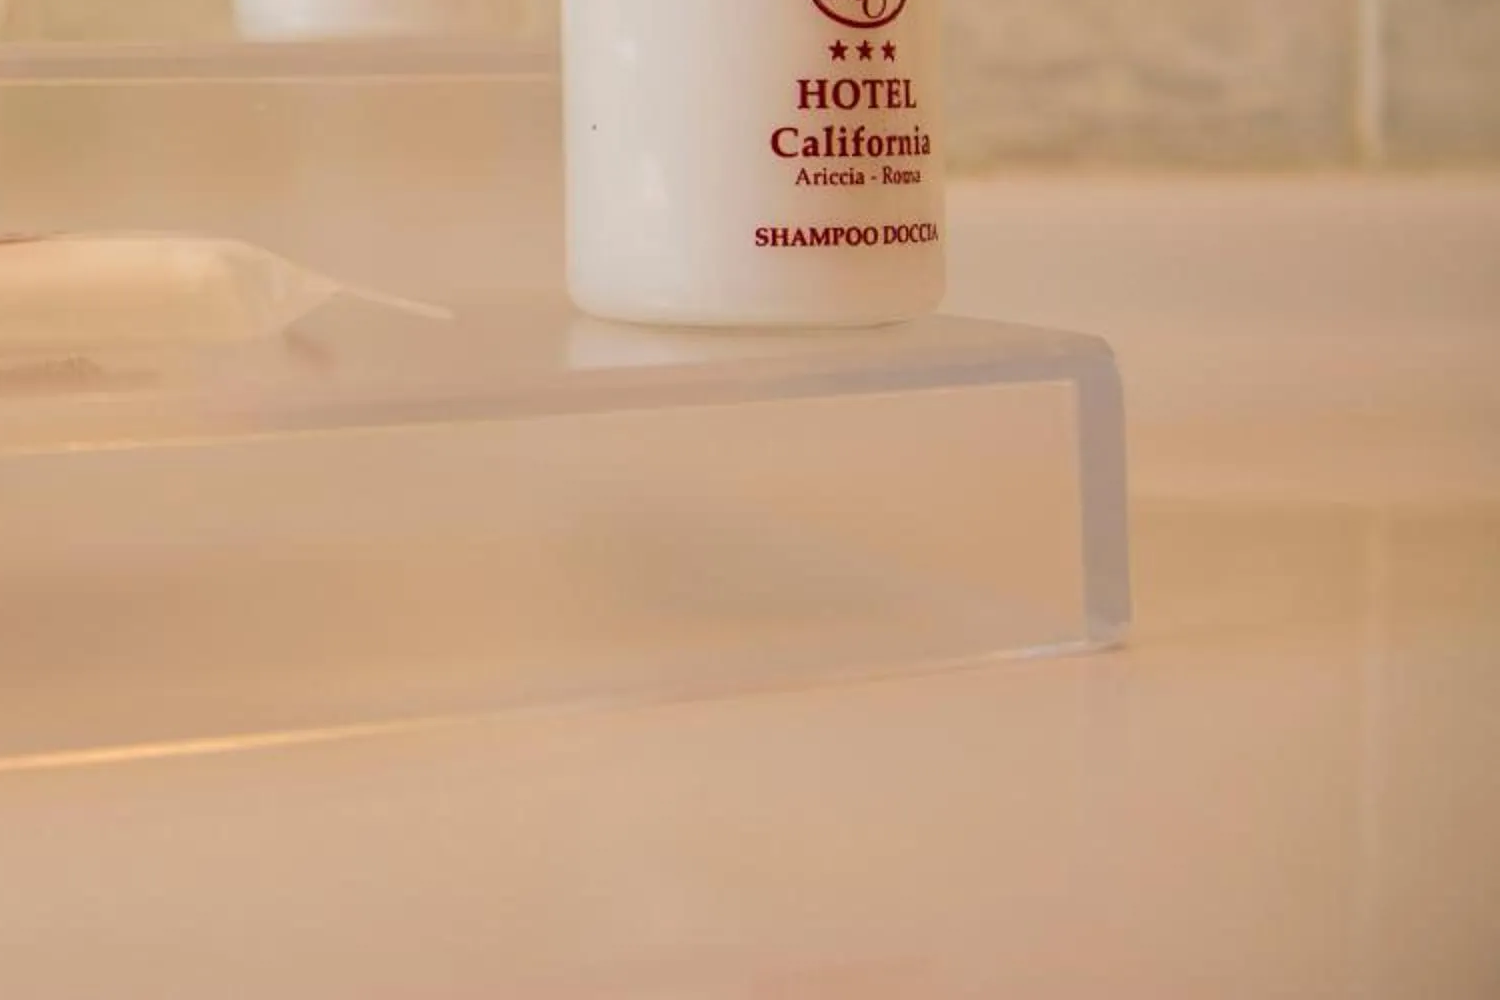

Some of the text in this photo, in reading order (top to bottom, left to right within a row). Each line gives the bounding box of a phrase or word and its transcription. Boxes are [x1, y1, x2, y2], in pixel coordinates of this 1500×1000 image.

[797, 78, 917, 111] HOTEL
[771, 125, 931, 158] California
[795, 167, 865, 185] Ariccia
[882, 166, 922, 185] Roma
[755, 223, 939, 247] SHAMPOO DOCCIA
